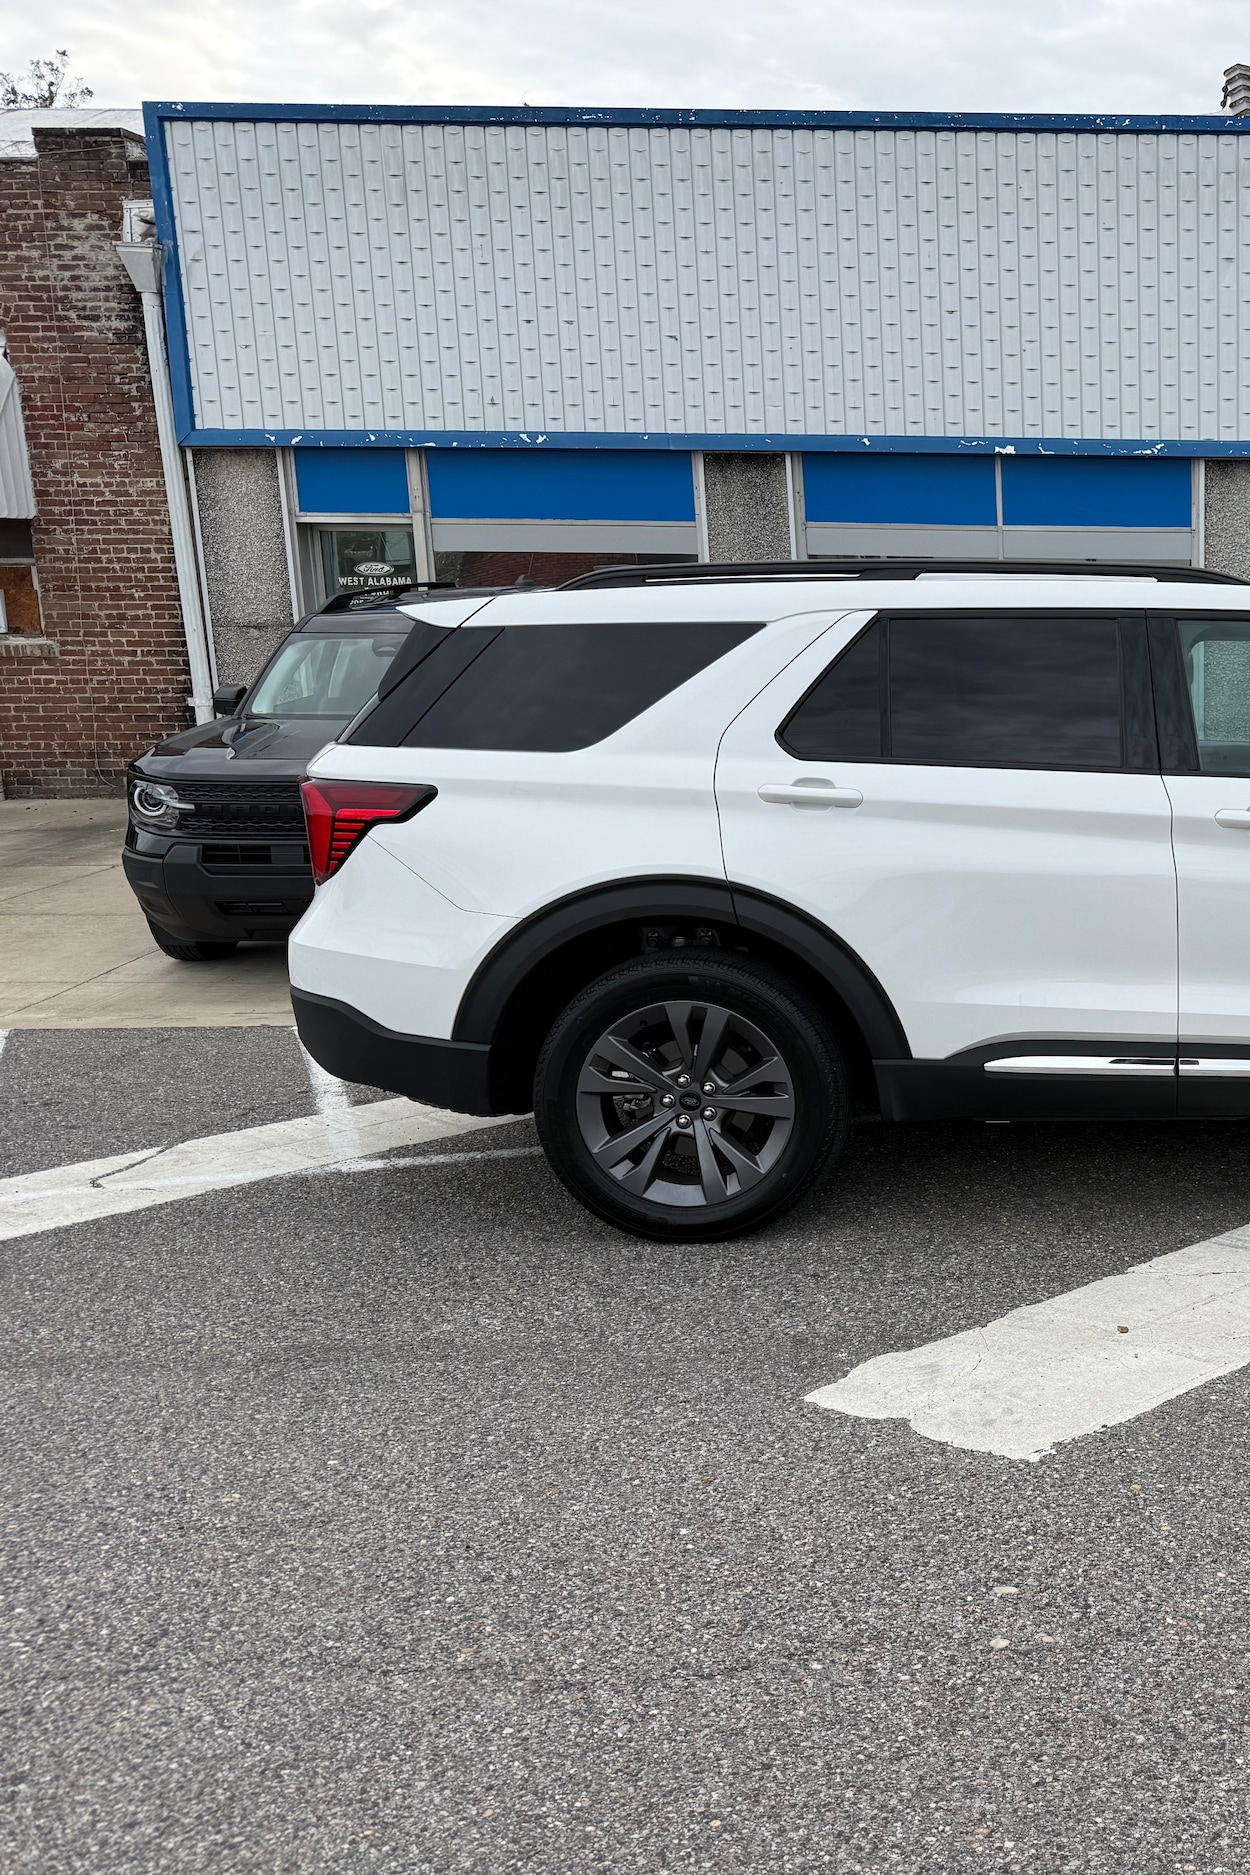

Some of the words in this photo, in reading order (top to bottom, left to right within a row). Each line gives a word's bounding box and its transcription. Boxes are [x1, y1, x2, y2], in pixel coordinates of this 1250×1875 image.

[363, 564, 385, 573] Ford
[338, 576, 364, 586] WEST
[367, 576, 412, 586] ALABAMA
